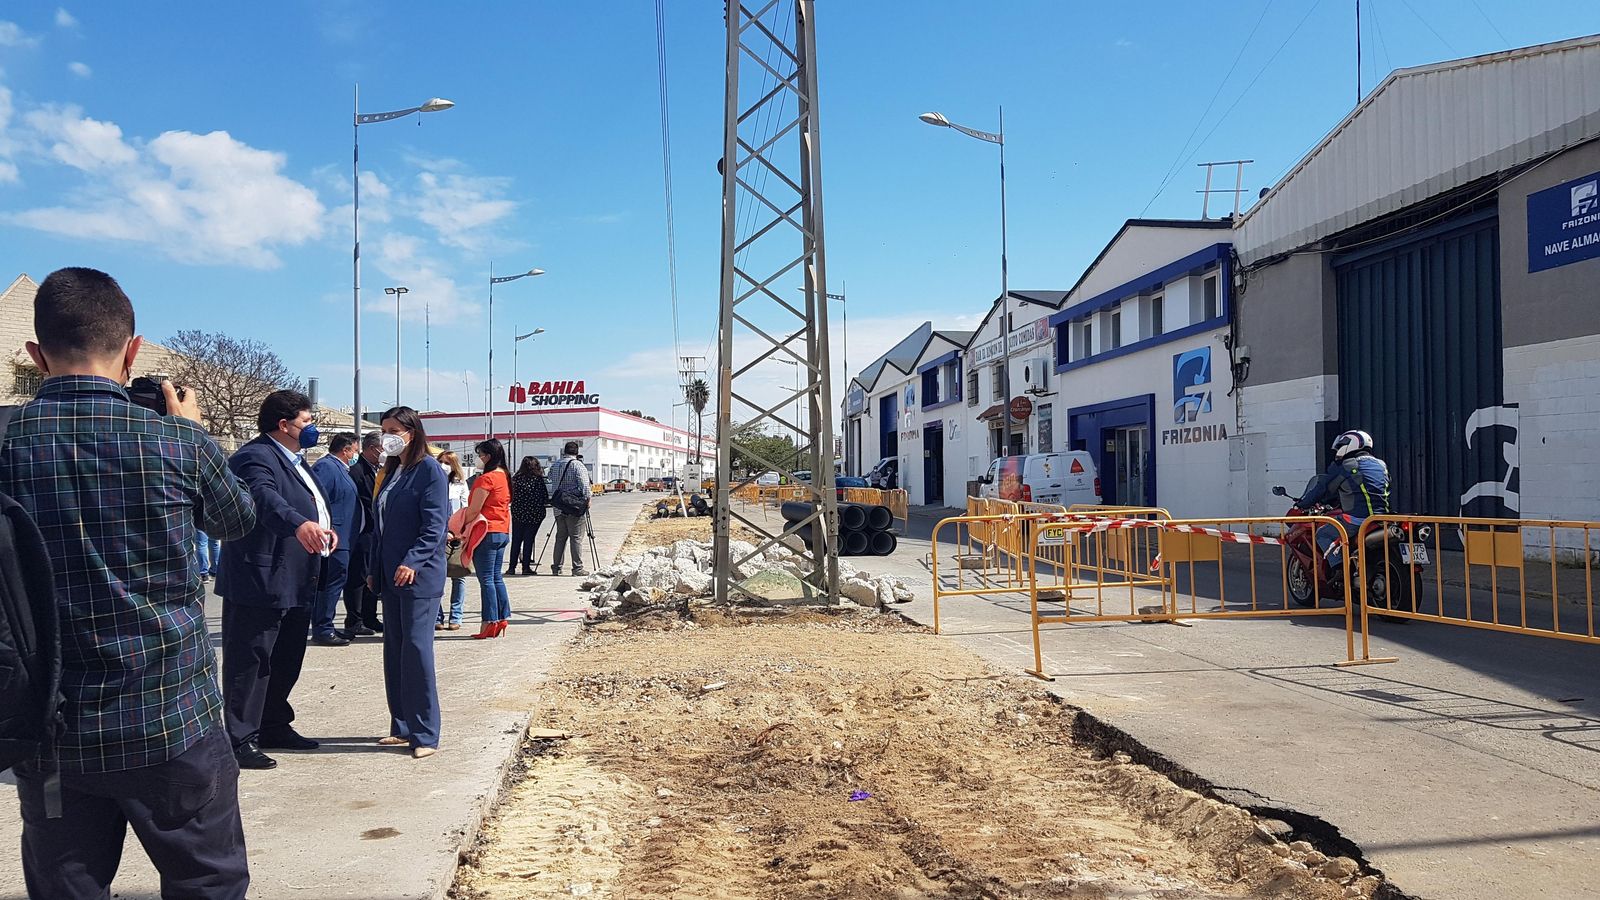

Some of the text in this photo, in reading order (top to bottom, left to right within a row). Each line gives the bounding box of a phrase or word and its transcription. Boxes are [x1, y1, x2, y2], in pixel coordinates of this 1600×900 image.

[1544, 240, 1569, 256] NAVE
[528, 380, 584, 395] BAHIA
[531, 394, 599, 406] SHOPPING
[1162, 423, 1228, 446] FRIZONIA
